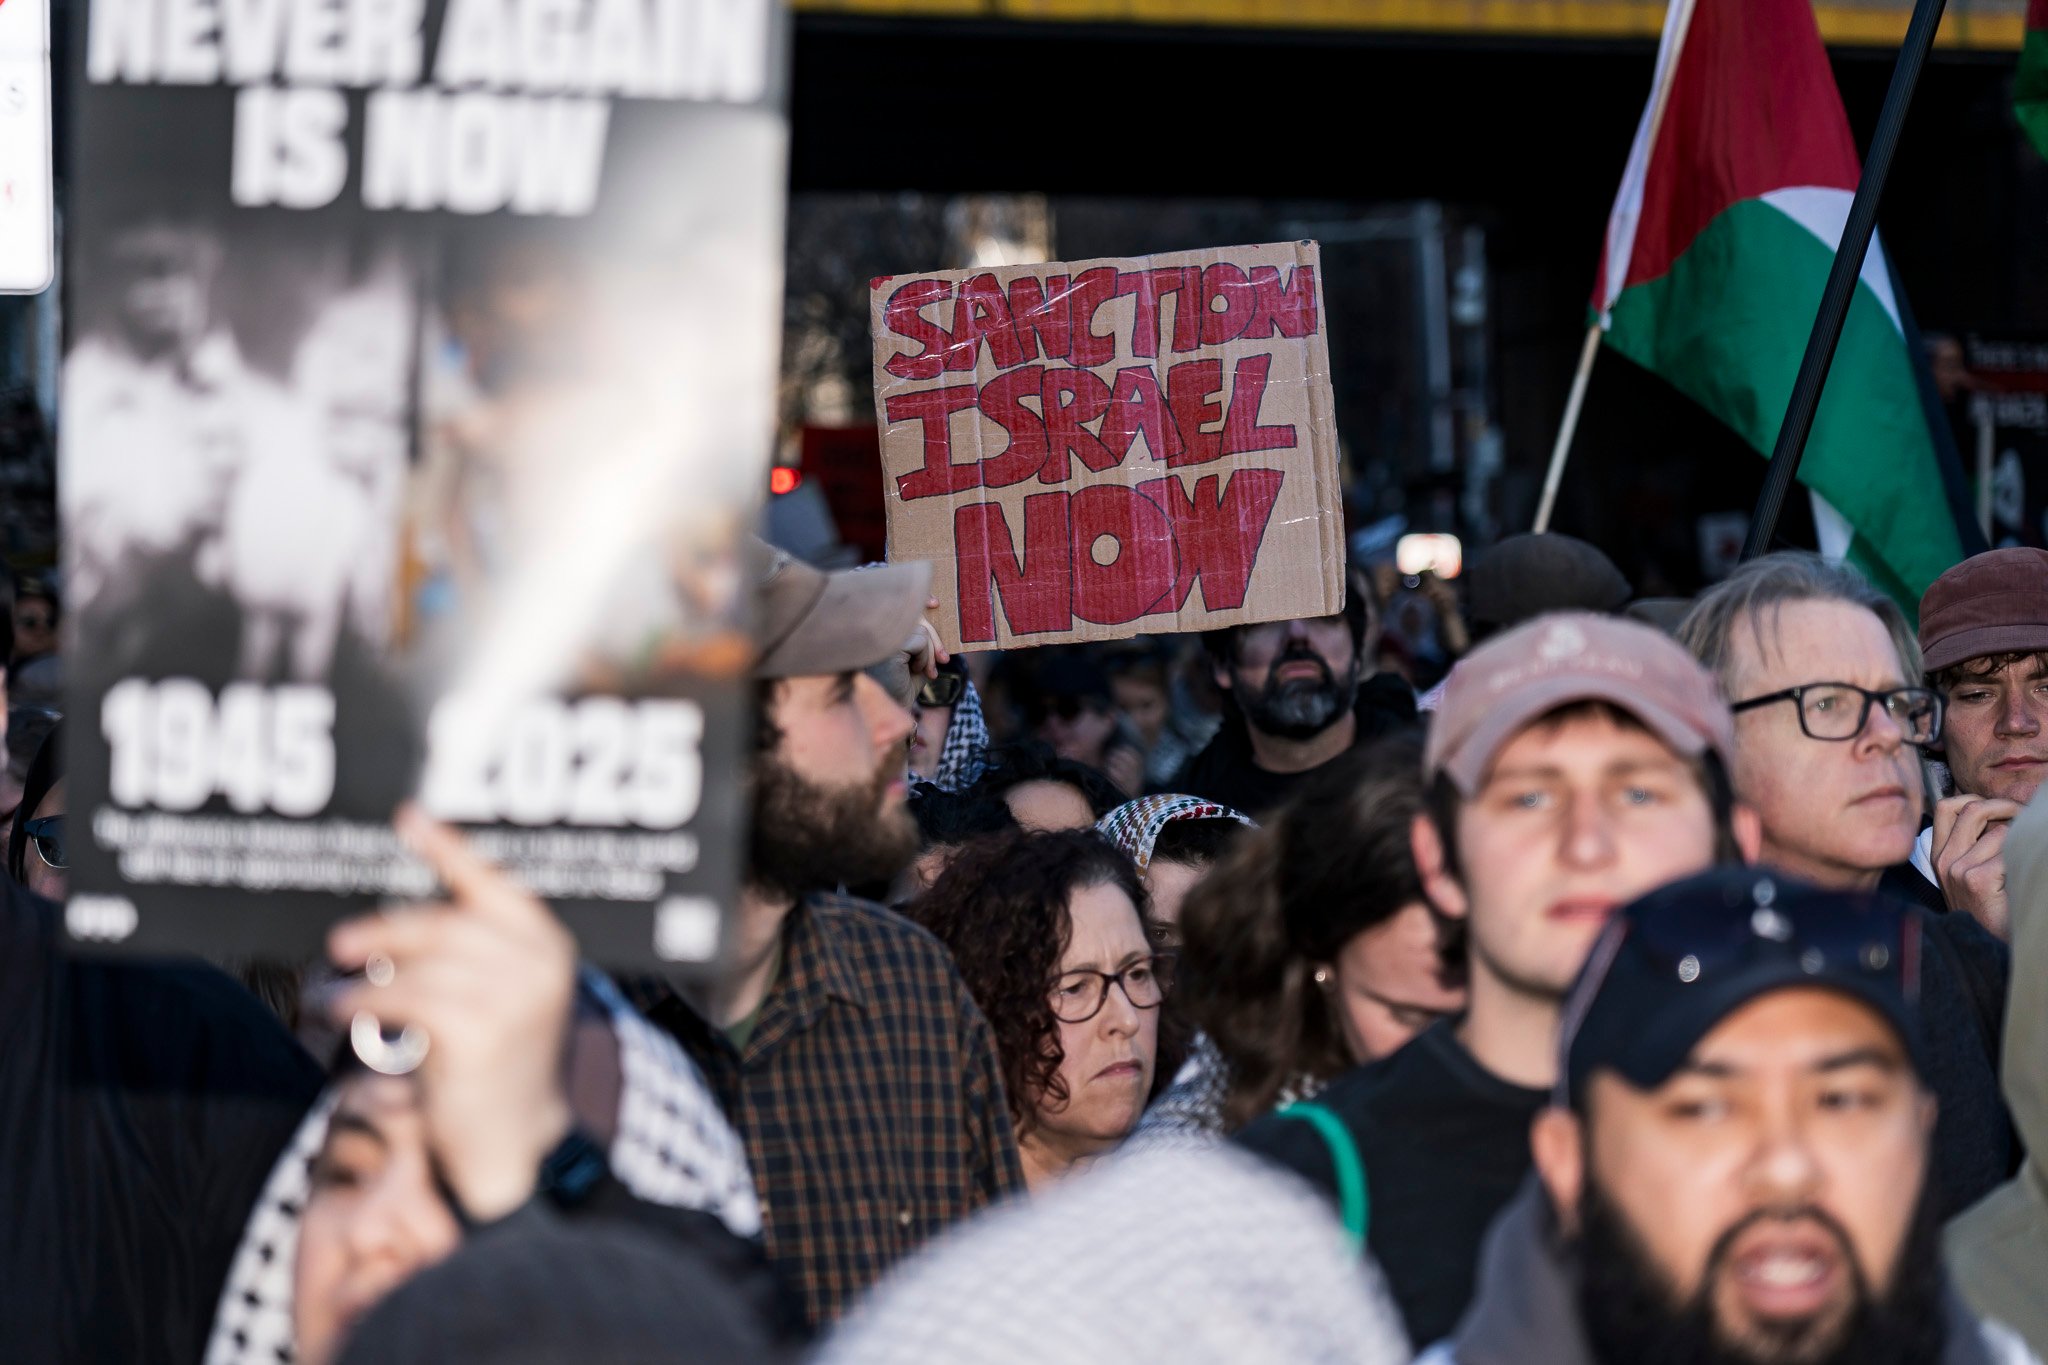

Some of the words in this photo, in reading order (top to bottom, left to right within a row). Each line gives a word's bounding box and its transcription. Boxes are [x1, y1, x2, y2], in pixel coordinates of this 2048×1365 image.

[87, 0, 425, 85] NEVER
[433, 0, 767, 100] AGAIN
[230, 85, 349, 209] IS
[361, 86, 611, 216] NOW
[883, 262, 1319, 380] SANCTION
[885, 353, 1298, 501] ISRAEL
[954, 468, 1285, 643] NOW
[101, 677, 337, 816] 1945
[424, 697, 704, 829] 2025
